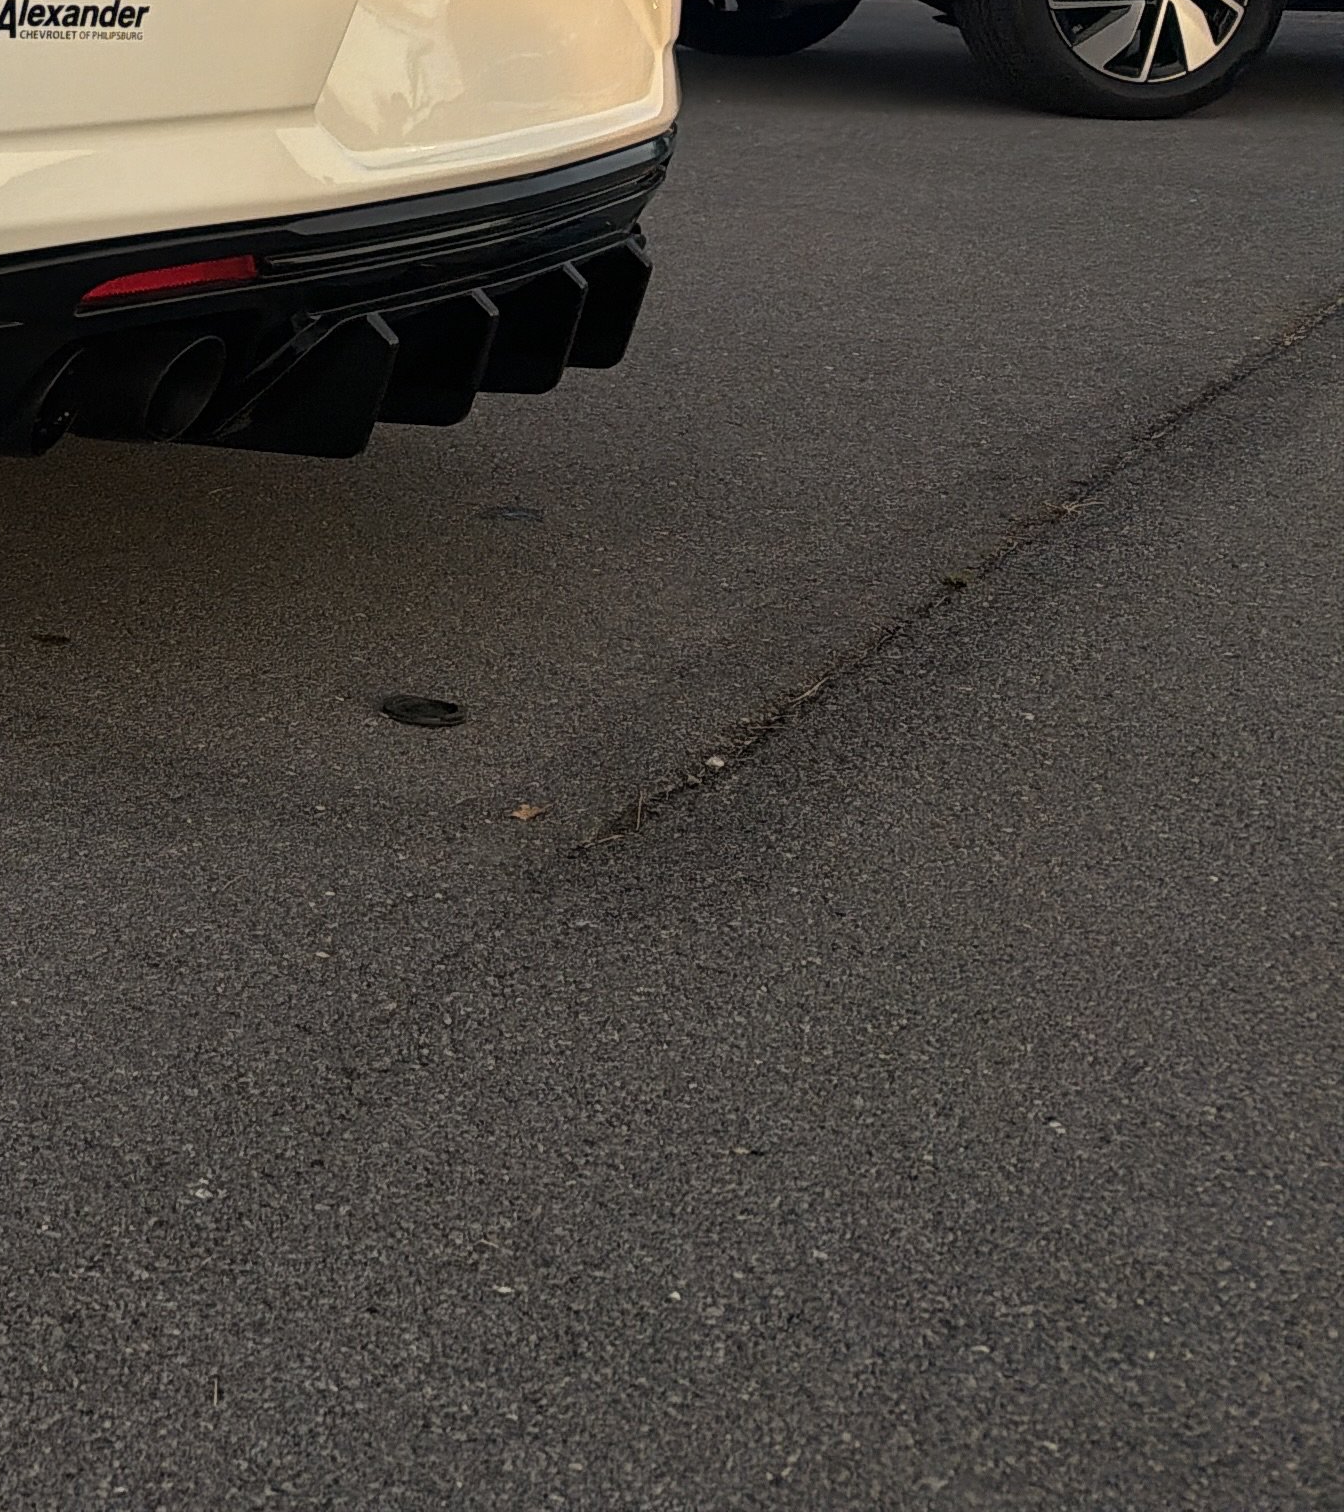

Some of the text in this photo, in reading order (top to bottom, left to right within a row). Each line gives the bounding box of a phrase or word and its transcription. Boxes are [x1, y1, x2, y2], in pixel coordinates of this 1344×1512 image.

[19, 30, 144, 41] CHEVROLET OF PHILIPSBURG
